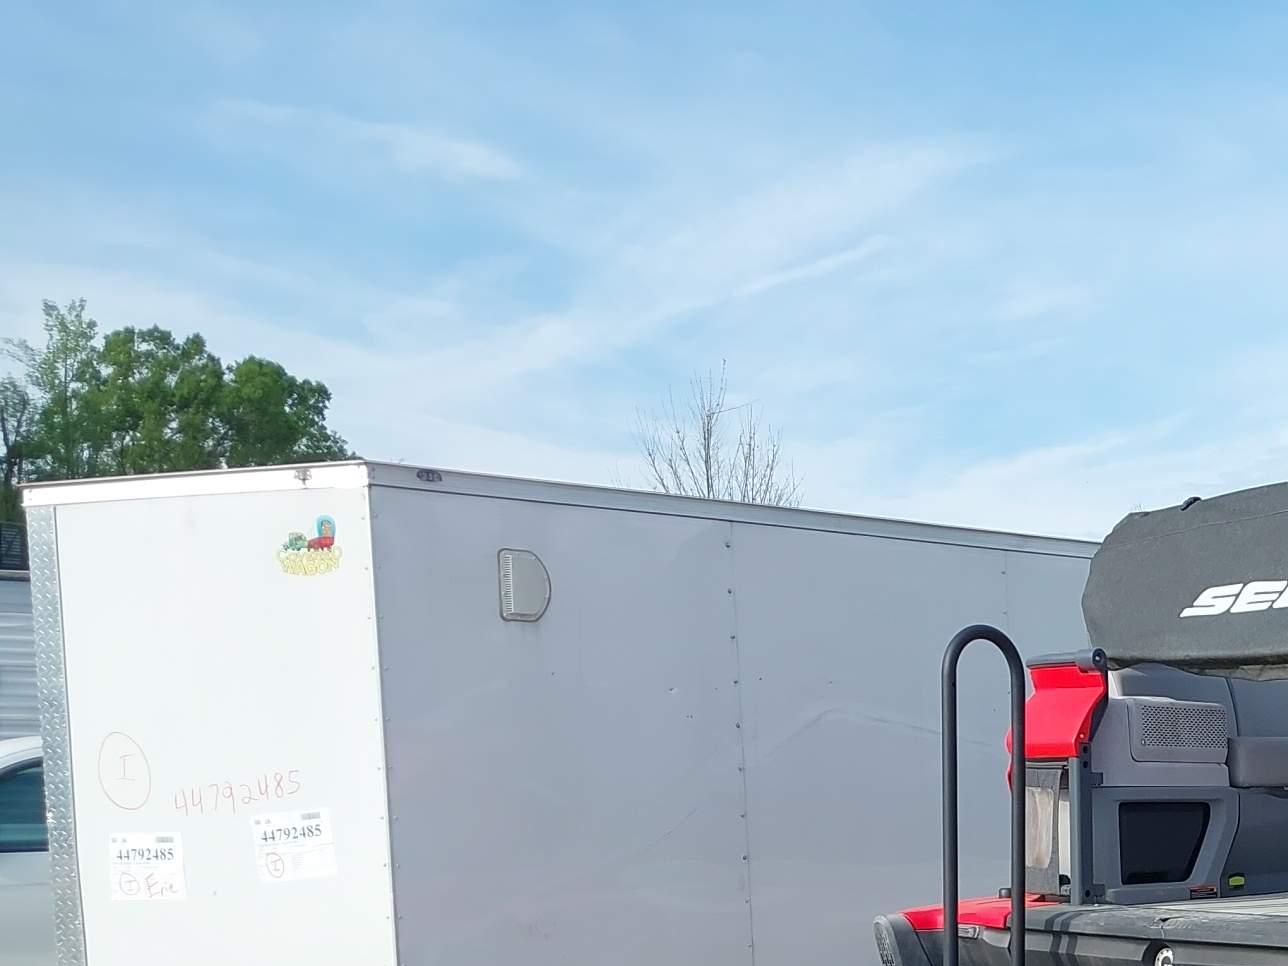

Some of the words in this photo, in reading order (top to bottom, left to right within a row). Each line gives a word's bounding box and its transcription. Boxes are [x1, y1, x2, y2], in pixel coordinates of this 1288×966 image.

[174, 769, 301, 816] 44792485
[261, 823, 322, 842] 44792485
[116, 847, 174, 861] 44792485
